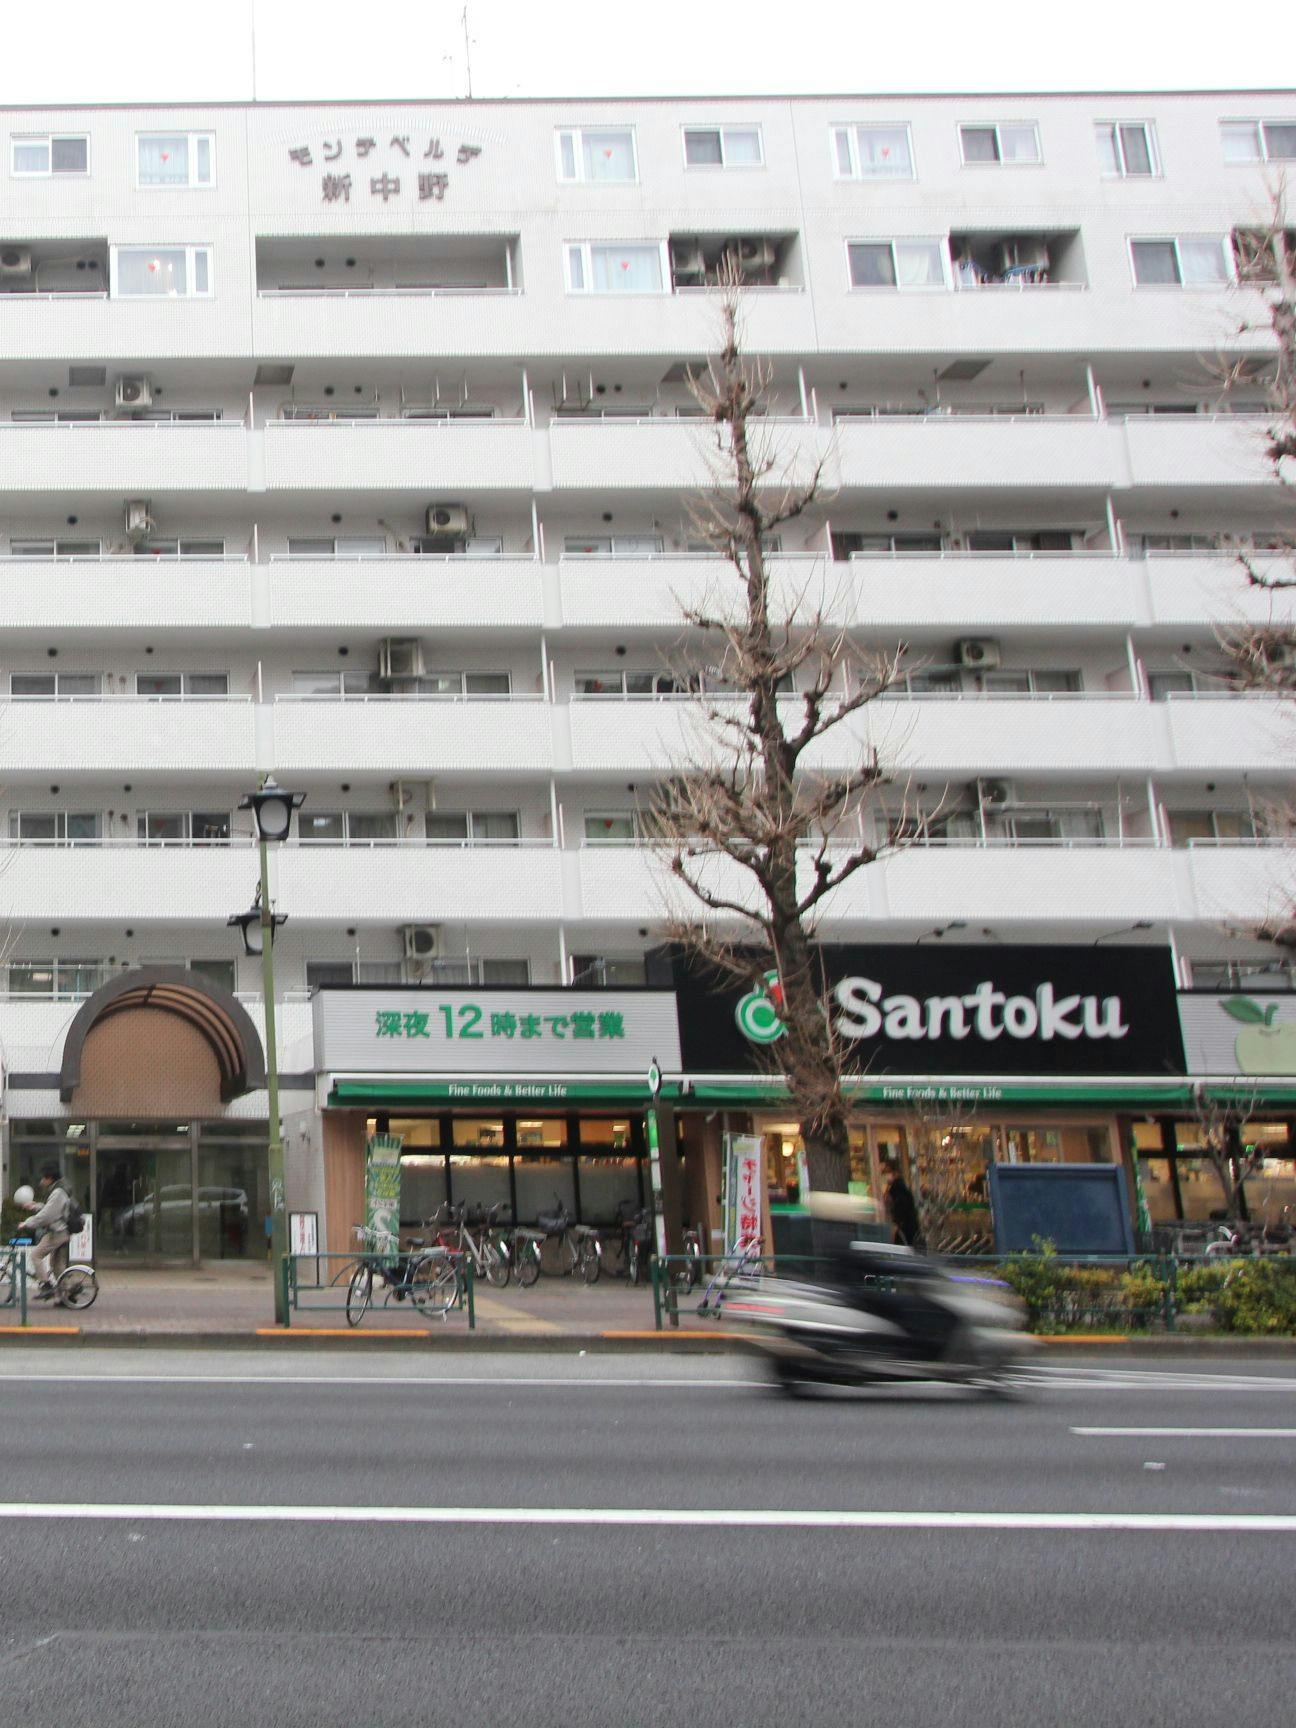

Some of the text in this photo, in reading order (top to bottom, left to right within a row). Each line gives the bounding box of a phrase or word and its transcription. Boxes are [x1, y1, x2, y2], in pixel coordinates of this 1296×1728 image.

[321, 171, 449, 202] 新中野
[375, 1003, 625, 1040] 深夜12時まで営業
[834, 976, 1130, 1040] Santoku
[448, 1083, 568, 1097] Fine Foods & Better Life
[883, 1086, 905, 1099] Fine
[907, 1086, 936, 1099] Foods
[949, 1087, 981, 1099] Better
[983, 1087, 1002, 1100] Life
